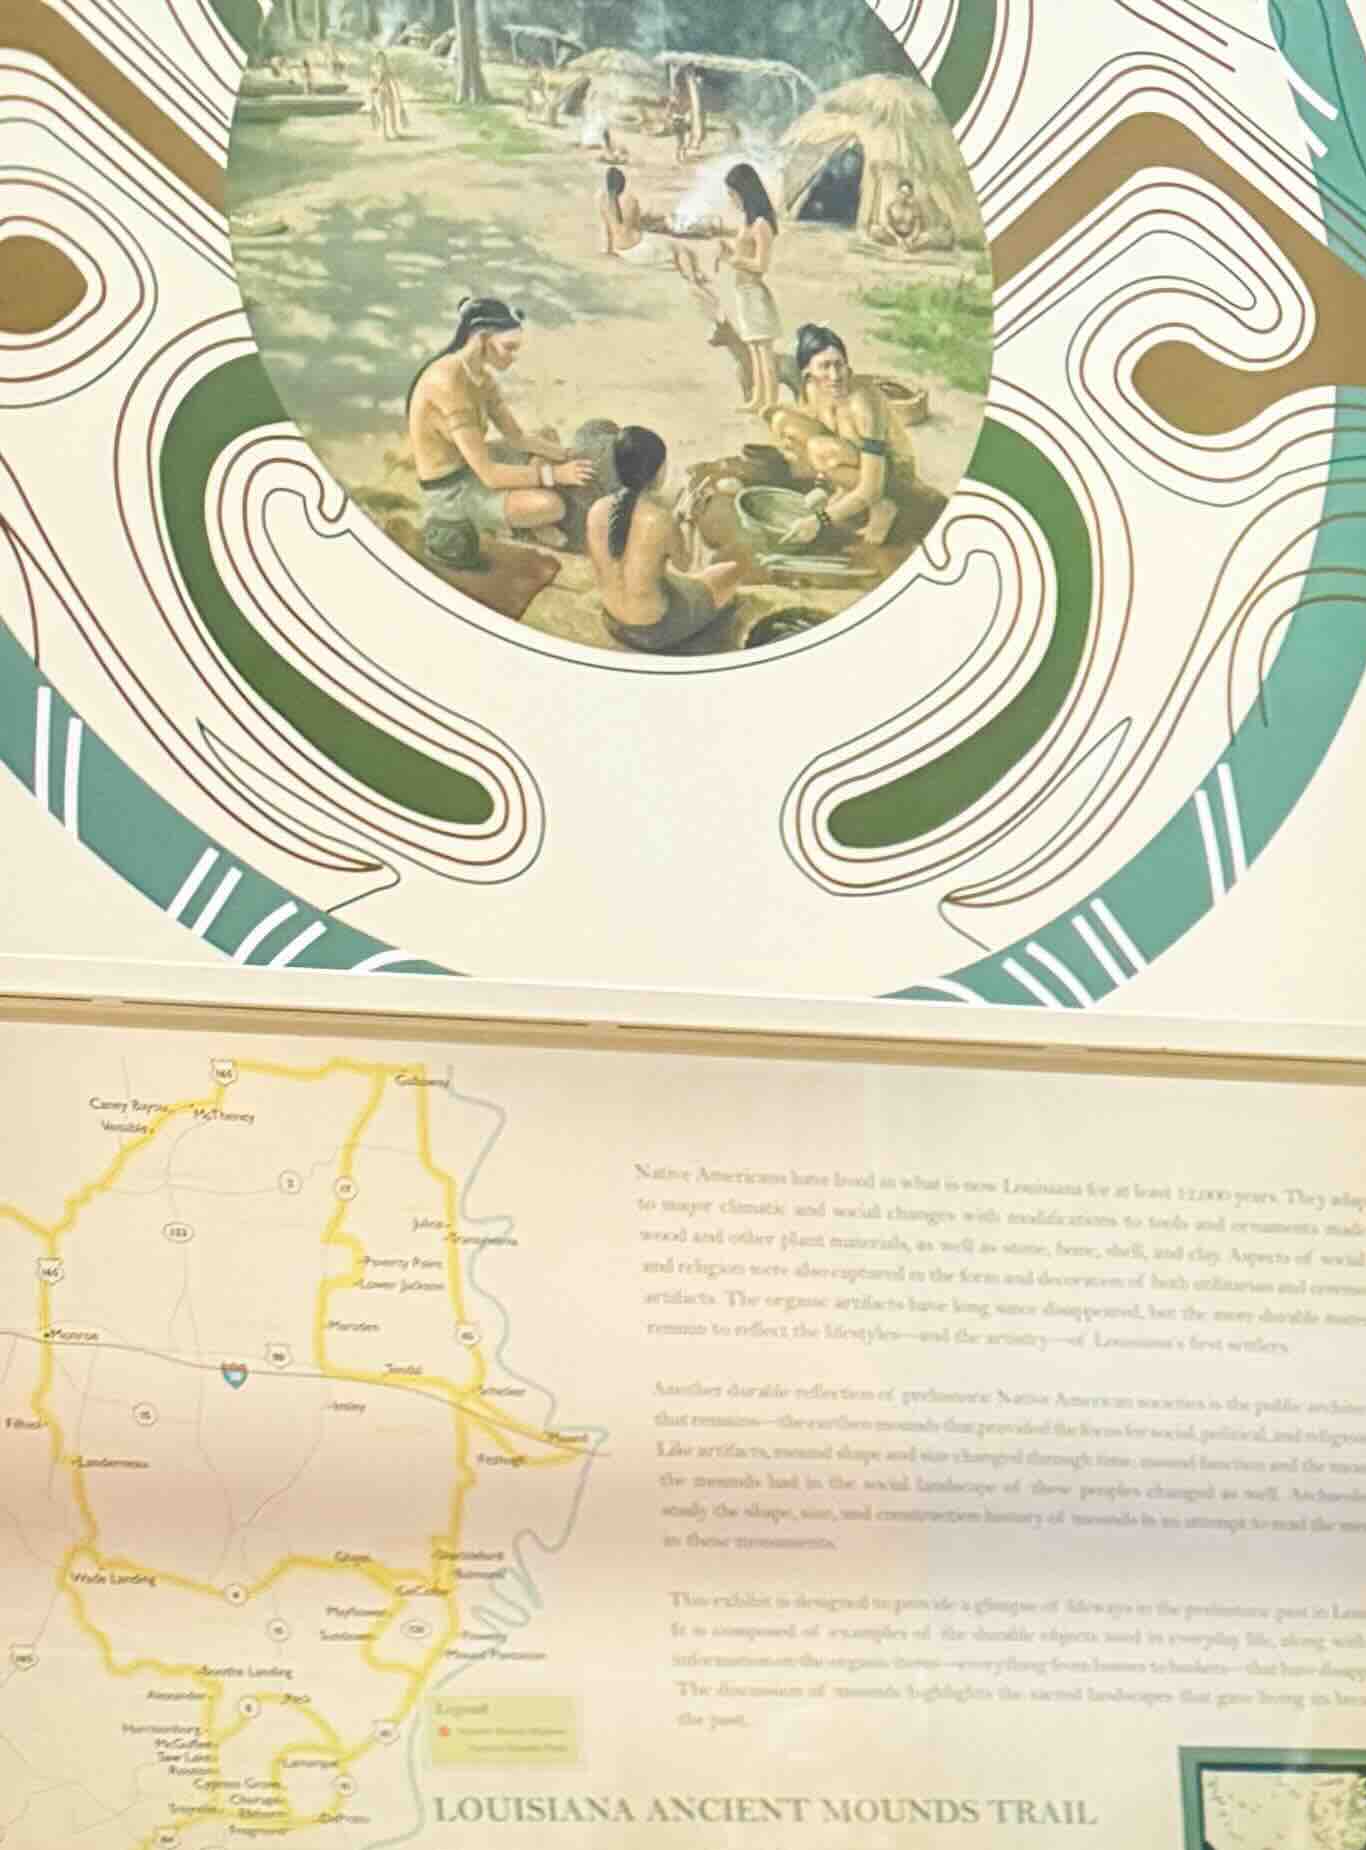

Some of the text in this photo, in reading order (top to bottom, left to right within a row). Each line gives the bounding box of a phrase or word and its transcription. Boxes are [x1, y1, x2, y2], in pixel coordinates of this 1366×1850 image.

[434, 1797, 1098, 1825] LOUISIANA ANCIENT MOUNDS TRAIL
